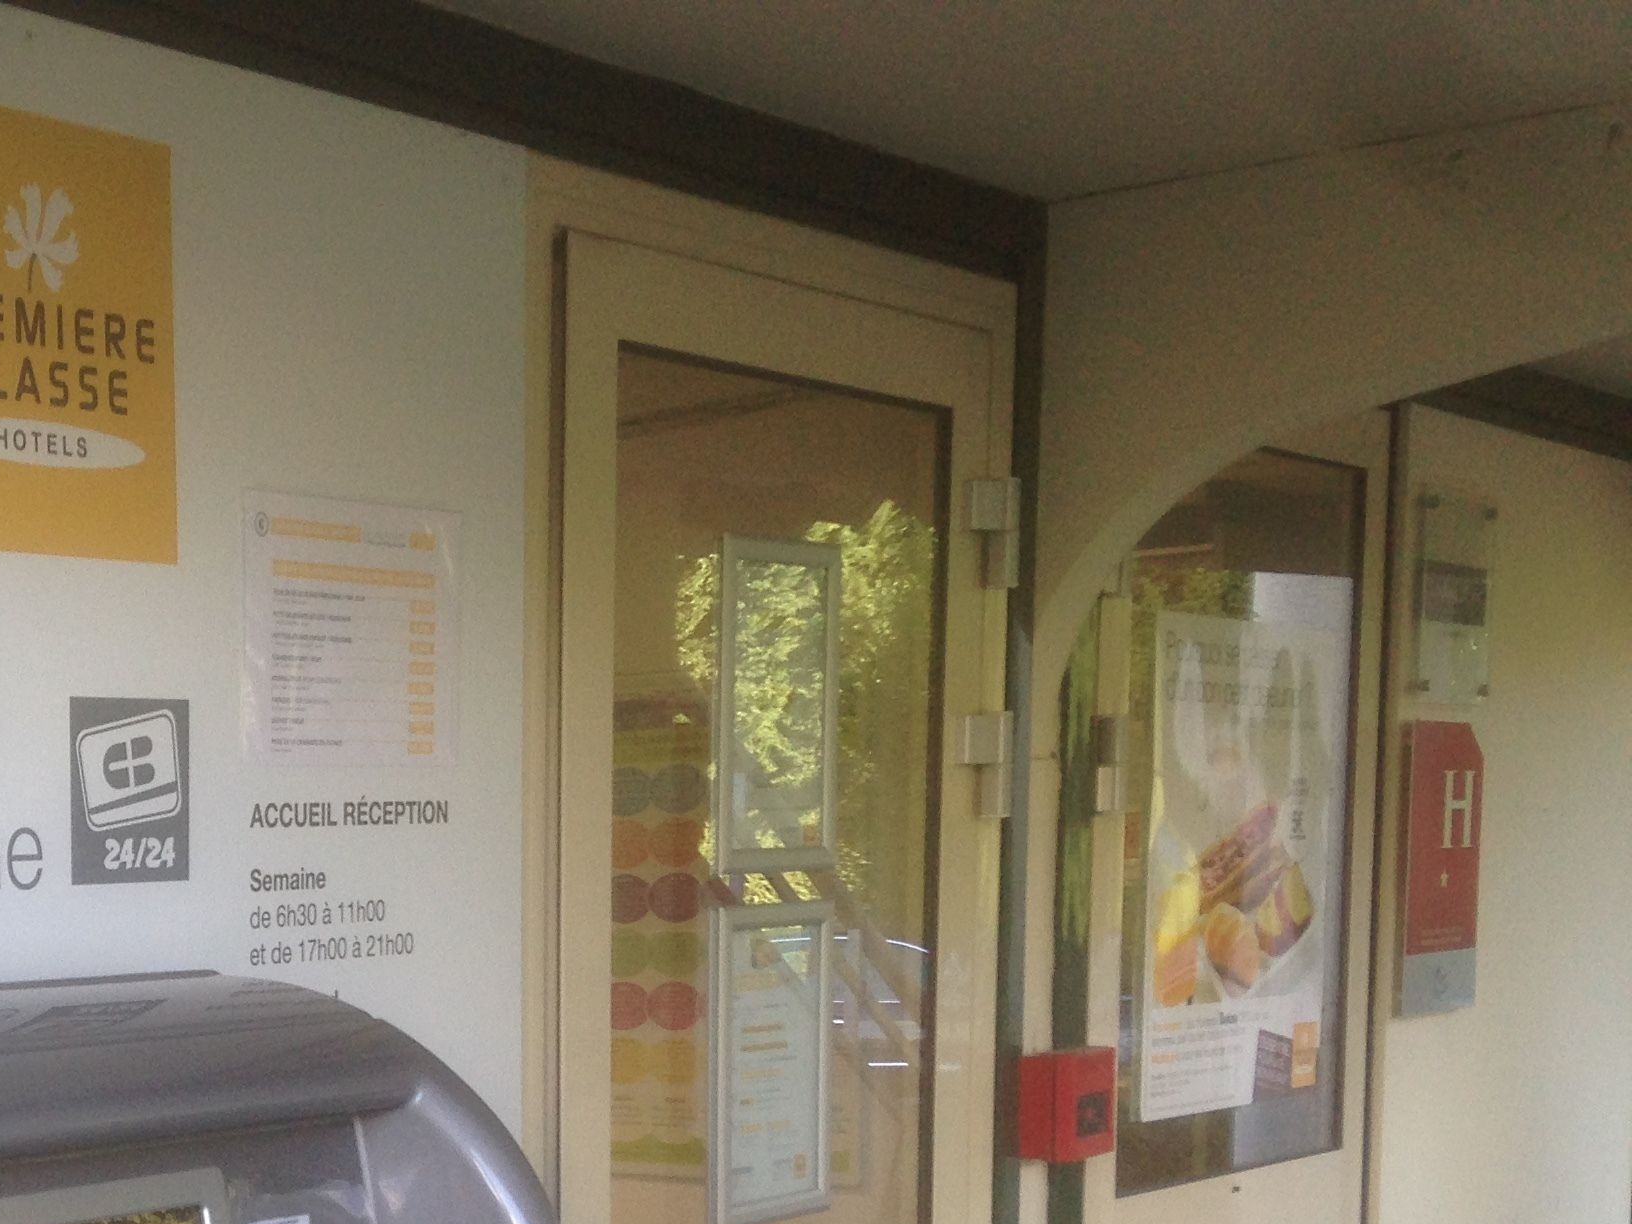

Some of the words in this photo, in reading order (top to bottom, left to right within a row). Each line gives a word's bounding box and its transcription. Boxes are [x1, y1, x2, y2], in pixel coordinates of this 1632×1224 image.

[249, 802, 338, 828] ACCUEIL
[343, 795, 449, 825] RÉCEPTION
[1441, 769, 1476, 849] H
[103, 836, 176, 870] 24/24
[249, 867, 326, 892] Semaine
[249, 906, 271, 929] de
[276, 903, 317, 927] 6h30
[322, 902, 333, 925] à
[338, 899, 385, 923] 11h00
[249, 944, 266, 966] et
[271, 942, 292, 964] de
[298, 937, 347, 962] 17h00
[352, 936, 362, 958] à
[366, 932, 414, 956] 21h00
